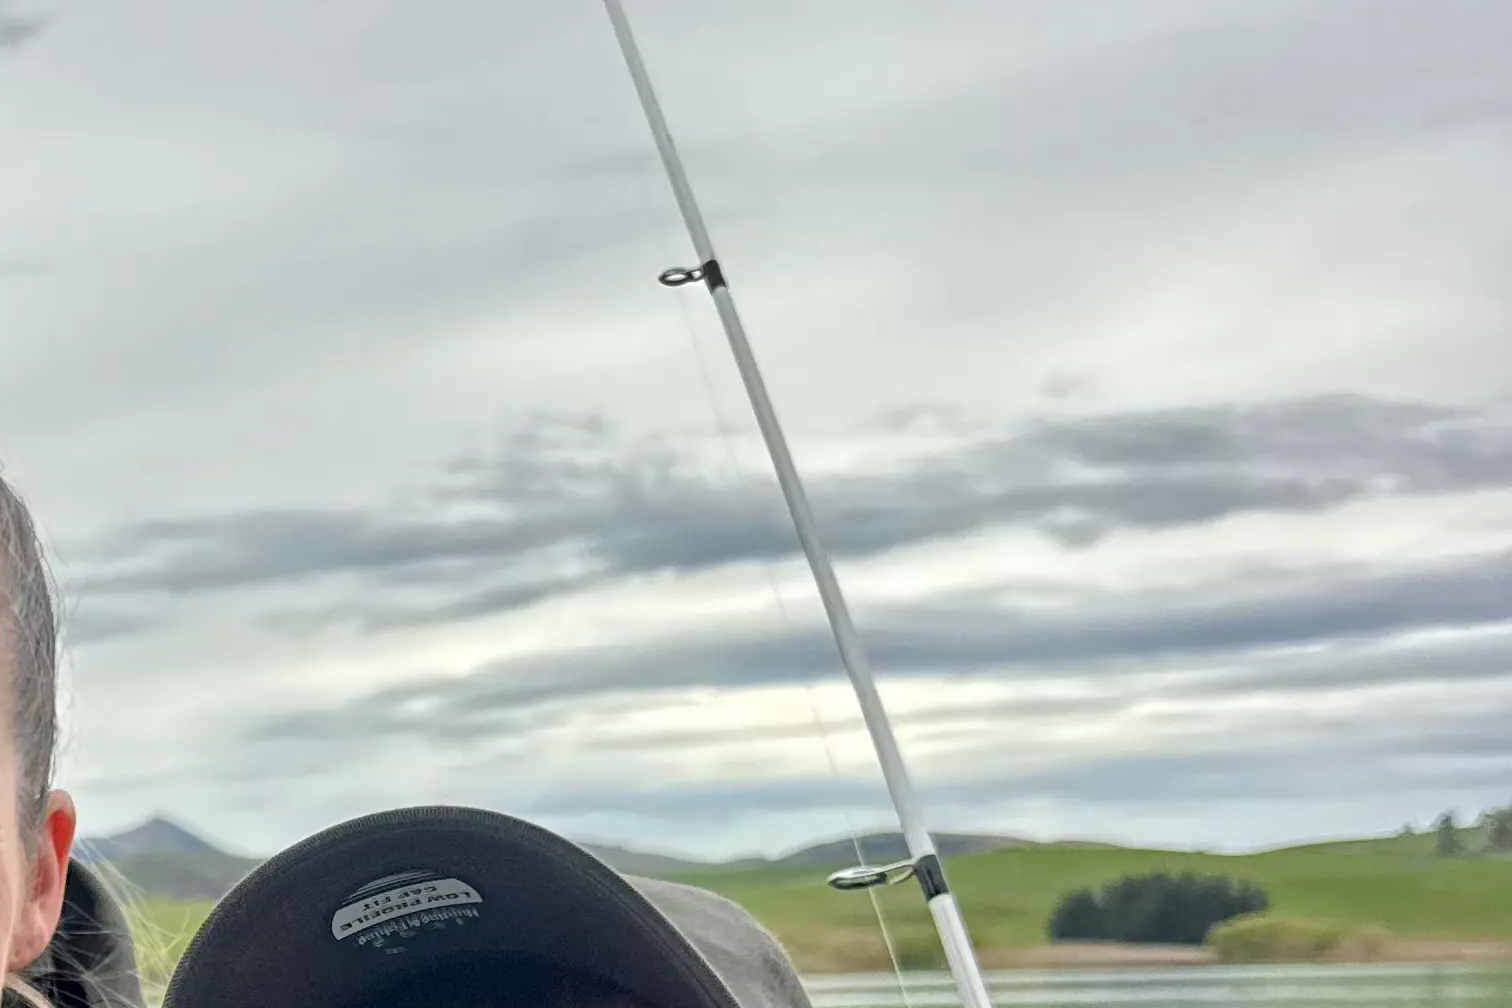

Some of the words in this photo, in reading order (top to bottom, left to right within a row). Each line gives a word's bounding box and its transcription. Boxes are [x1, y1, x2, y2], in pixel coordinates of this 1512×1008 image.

[397, 886, 437, 899] CAP
[427, 891, 472, 903] LOW
[362, 896, 392, 911] FIT
[339, 898, 421, 932] PROFILE
